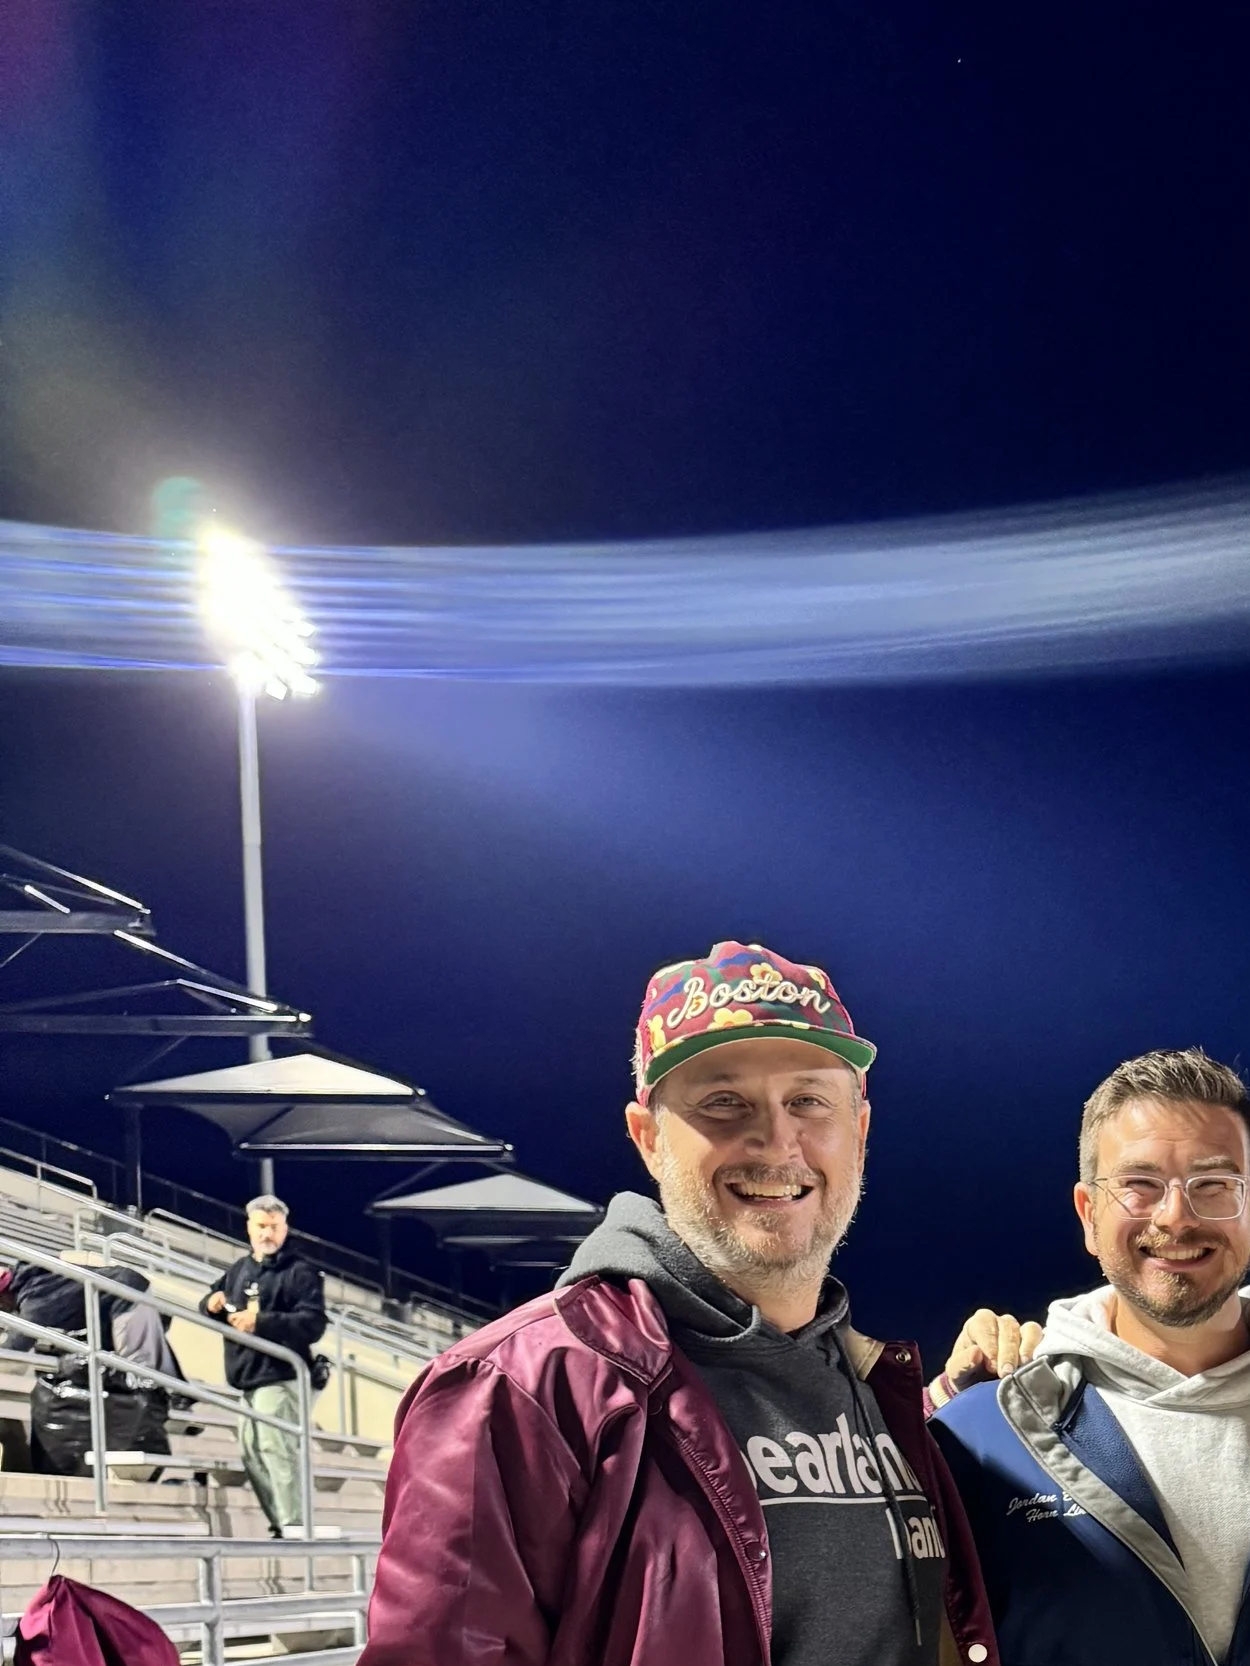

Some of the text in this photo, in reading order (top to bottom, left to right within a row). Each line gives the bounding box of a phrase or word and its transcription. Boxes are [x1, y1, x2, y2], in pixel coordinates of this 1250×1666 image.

[667, 976, 831, 1028] Boston
[741, 1412, 923, 1494] earlan
[1006, 1493, 1057, 1515] Jordan
[1026, 1503, 1087, 1522] Horn Lin
